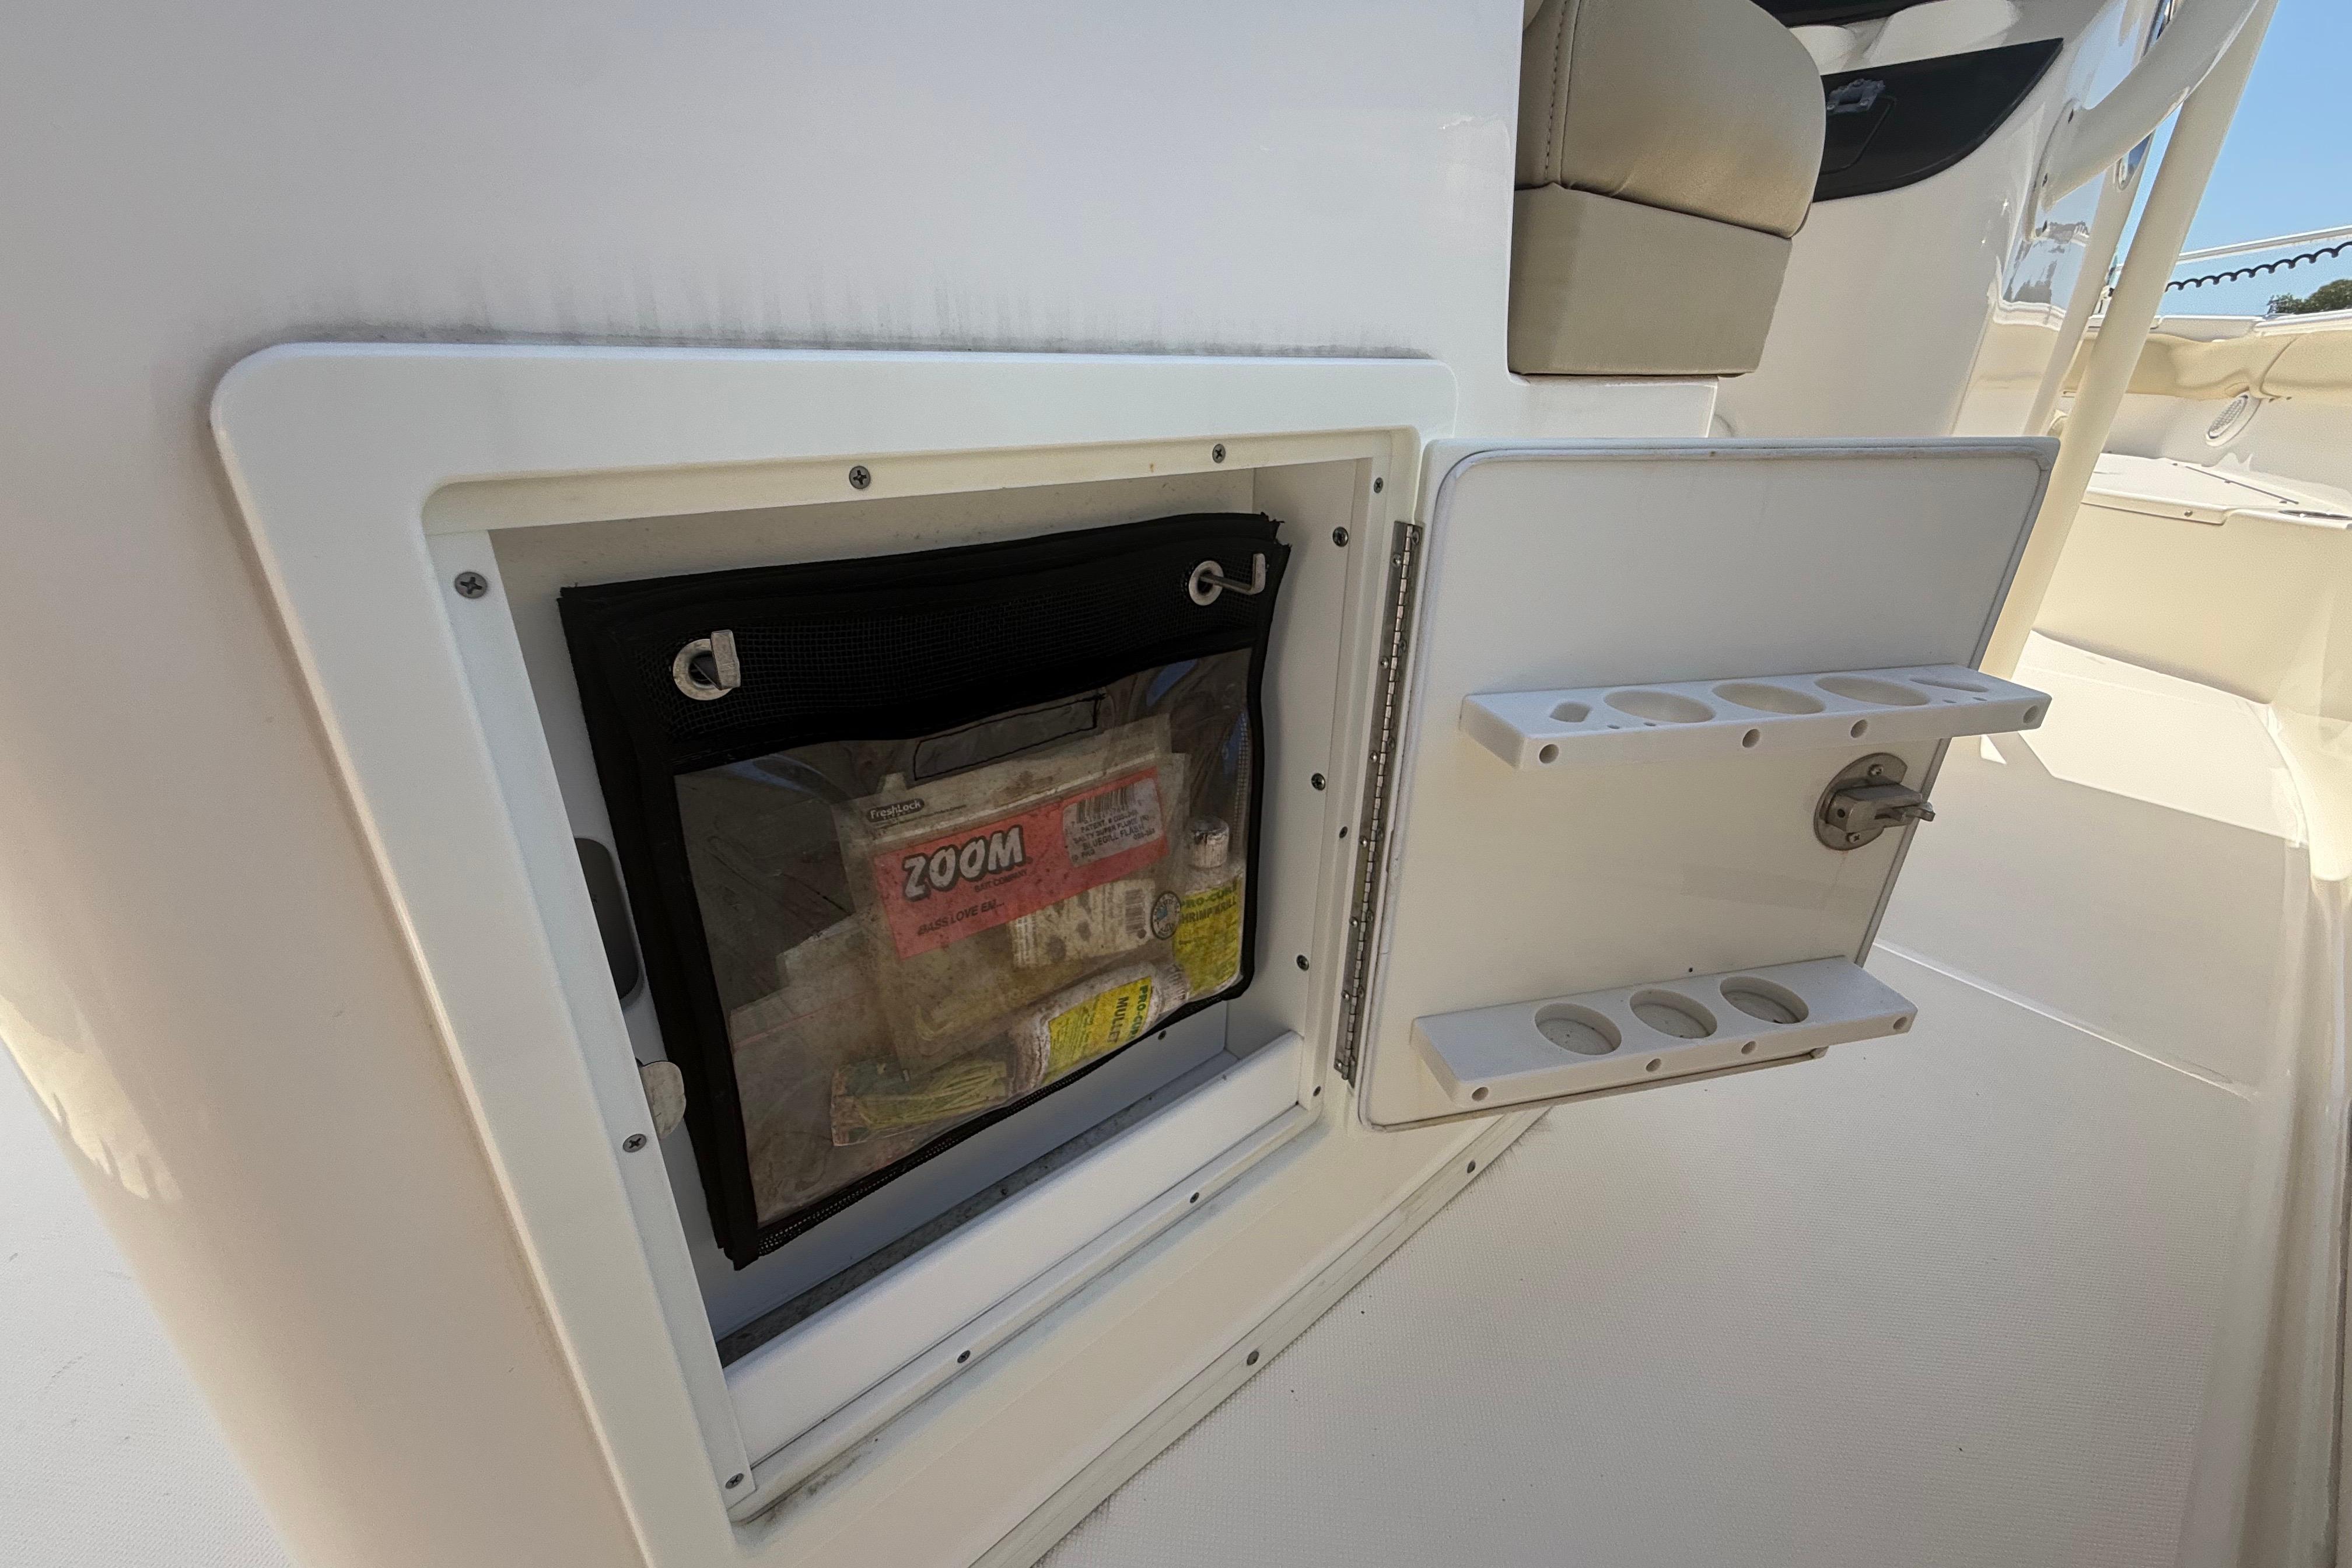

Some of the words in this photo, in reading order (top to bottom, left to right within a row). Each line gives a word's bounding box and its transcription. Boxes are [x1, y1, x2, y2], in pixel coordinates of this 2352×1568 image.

[870, 800, 922, 818] FreshLock
[1083, 834, 1119, 850] BLUEGILL
[1119, 823, 1144, 837] FLASH
[1096, 824, 1116, 836] SUPER
[902, 824, 1026, 902] ZOOM
[918, 915, 949, 935] BASS
[950, 905, 978, 924] LOVE
[1108, 996, 1130, 1044] MULLET
